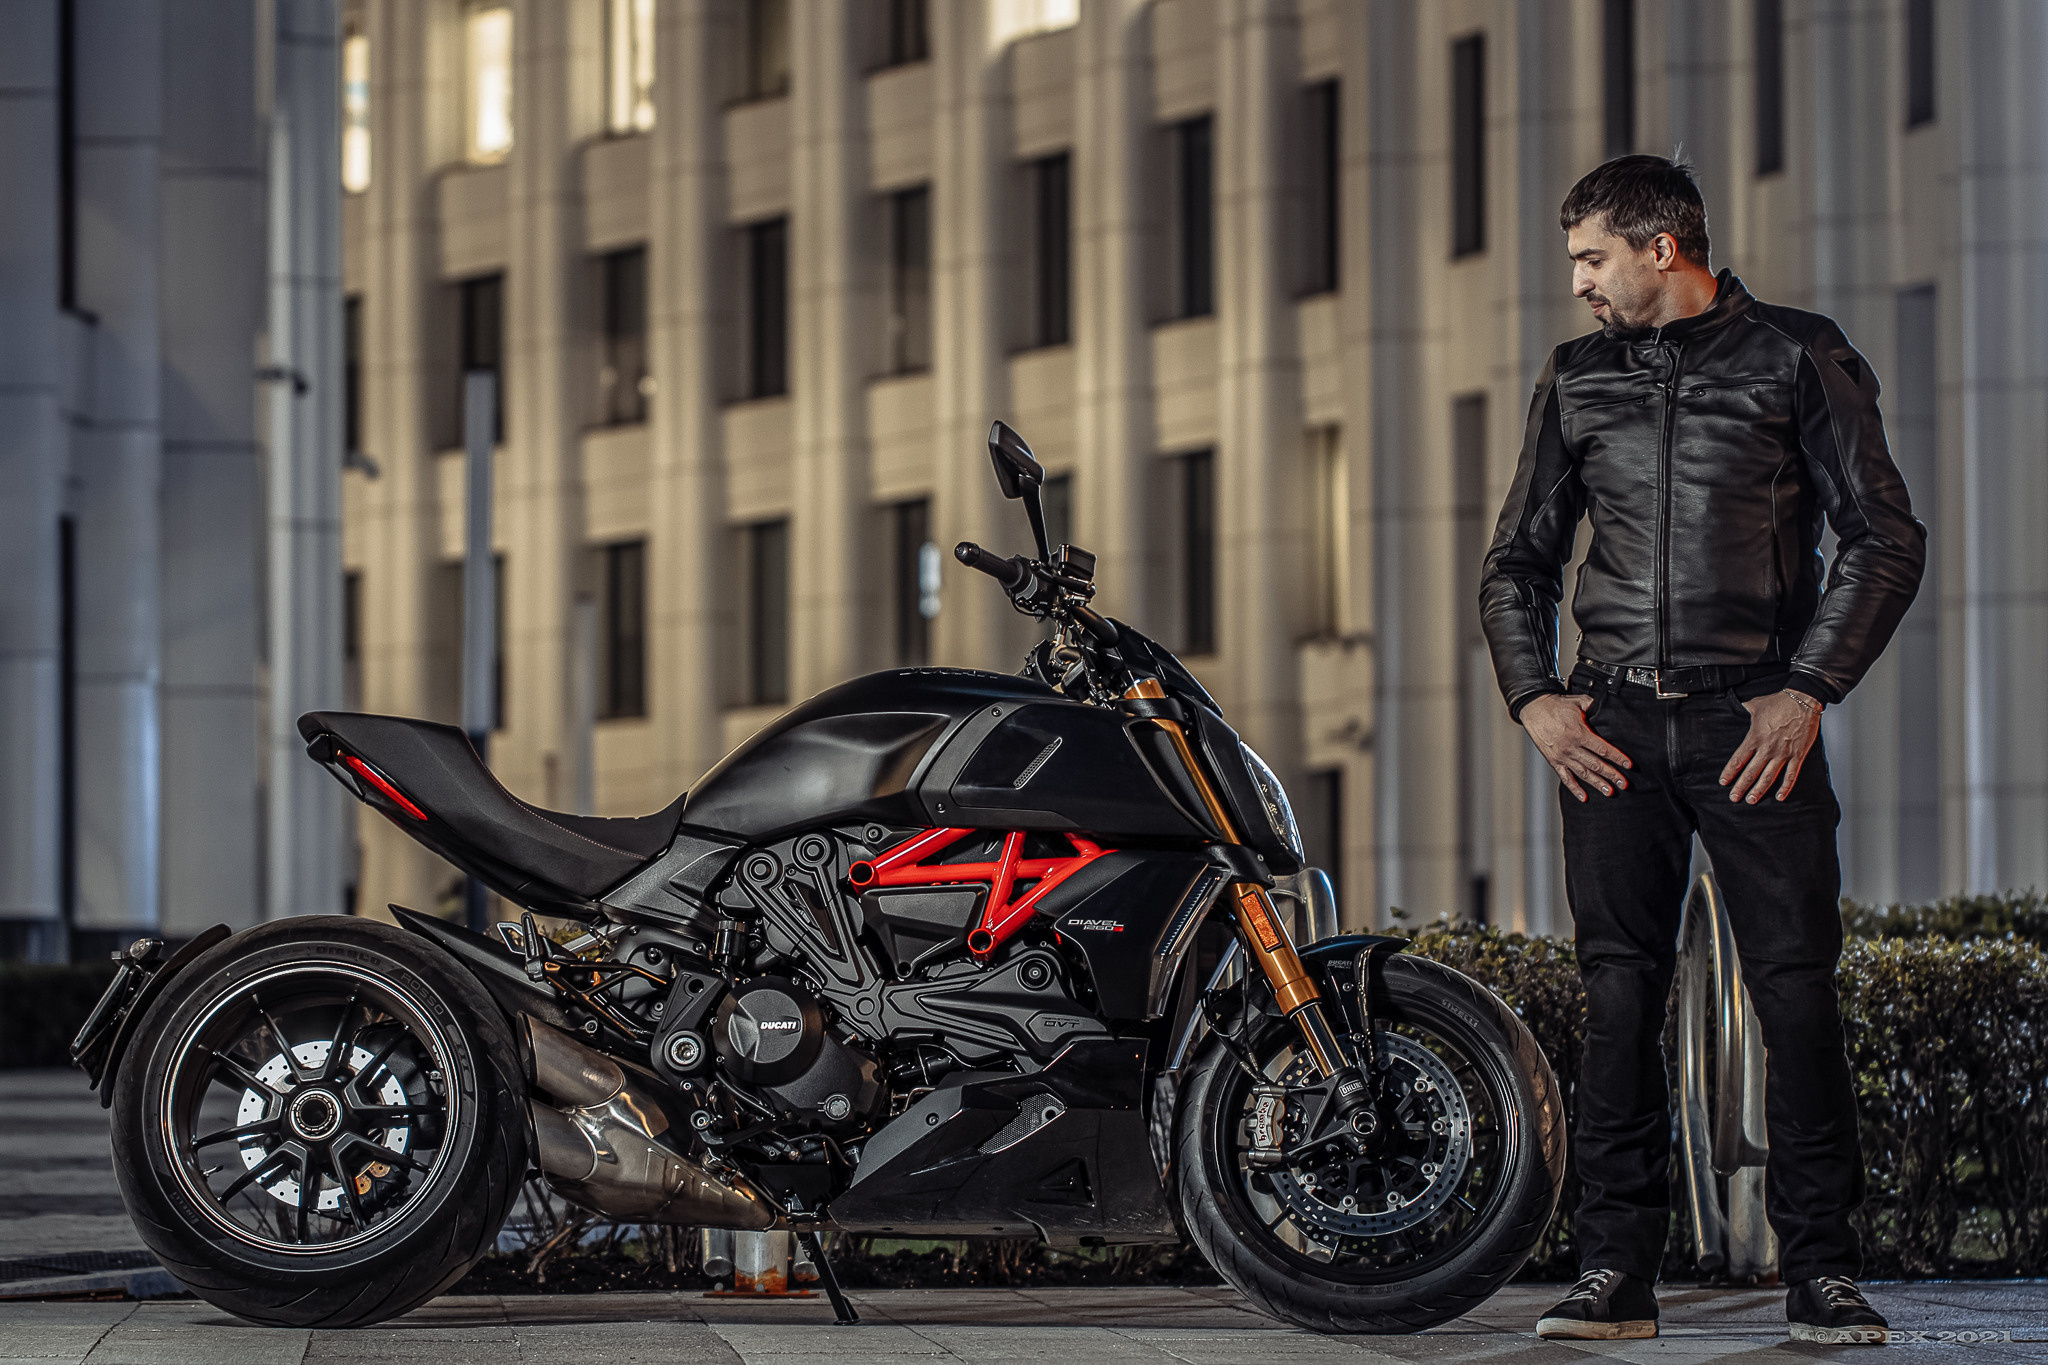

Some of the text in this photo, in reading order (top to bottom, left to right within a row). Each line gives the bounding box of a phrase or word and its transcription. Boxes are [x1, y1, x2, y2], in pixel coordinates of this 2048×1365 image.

[1067, 919, 1124, 927] DIAVEL
[400, 972, 444, 1016] ROSSO
[760, 1021, 797, 1030] DUCATI
[1258, 1102, 1269, 1142] brembo
